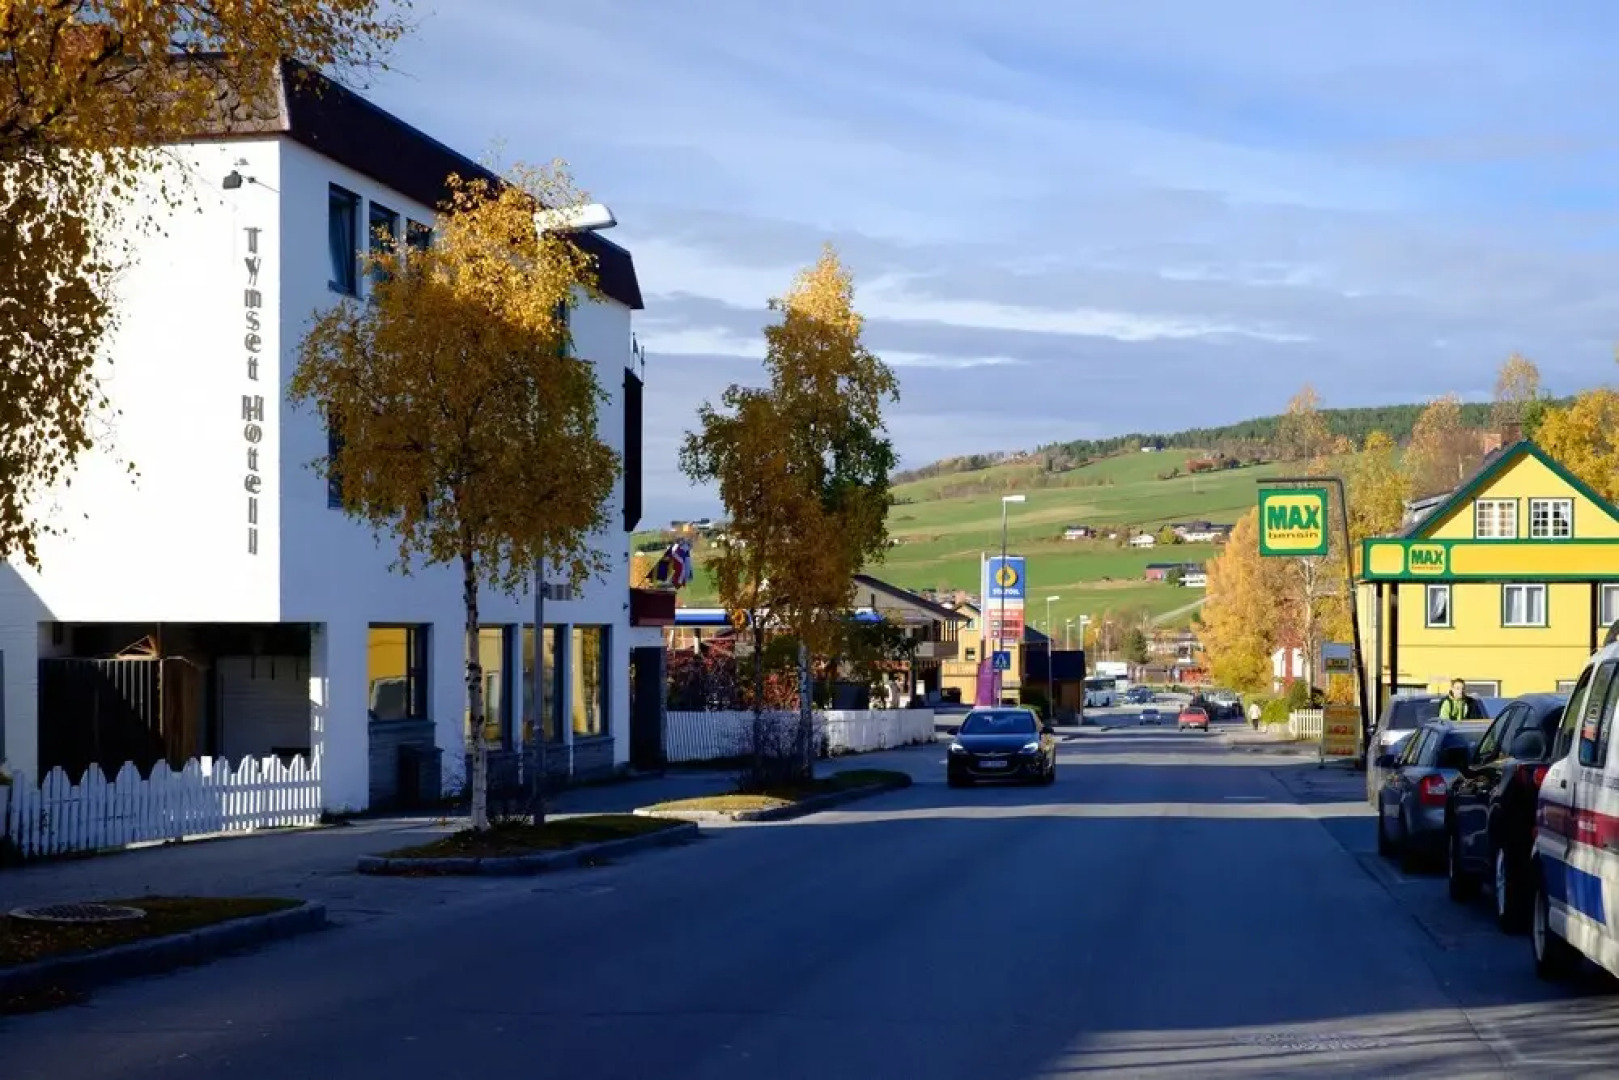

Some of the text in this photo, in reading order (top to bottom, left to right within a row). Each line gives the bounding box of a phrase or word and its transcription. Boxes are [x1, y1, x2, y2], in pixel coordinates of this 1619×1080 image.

[241, 227, 264, 556] Tynset Hotell
[1267, 505, 1320, 529] MAX
[1411, 550, 1443, 565] MAX
